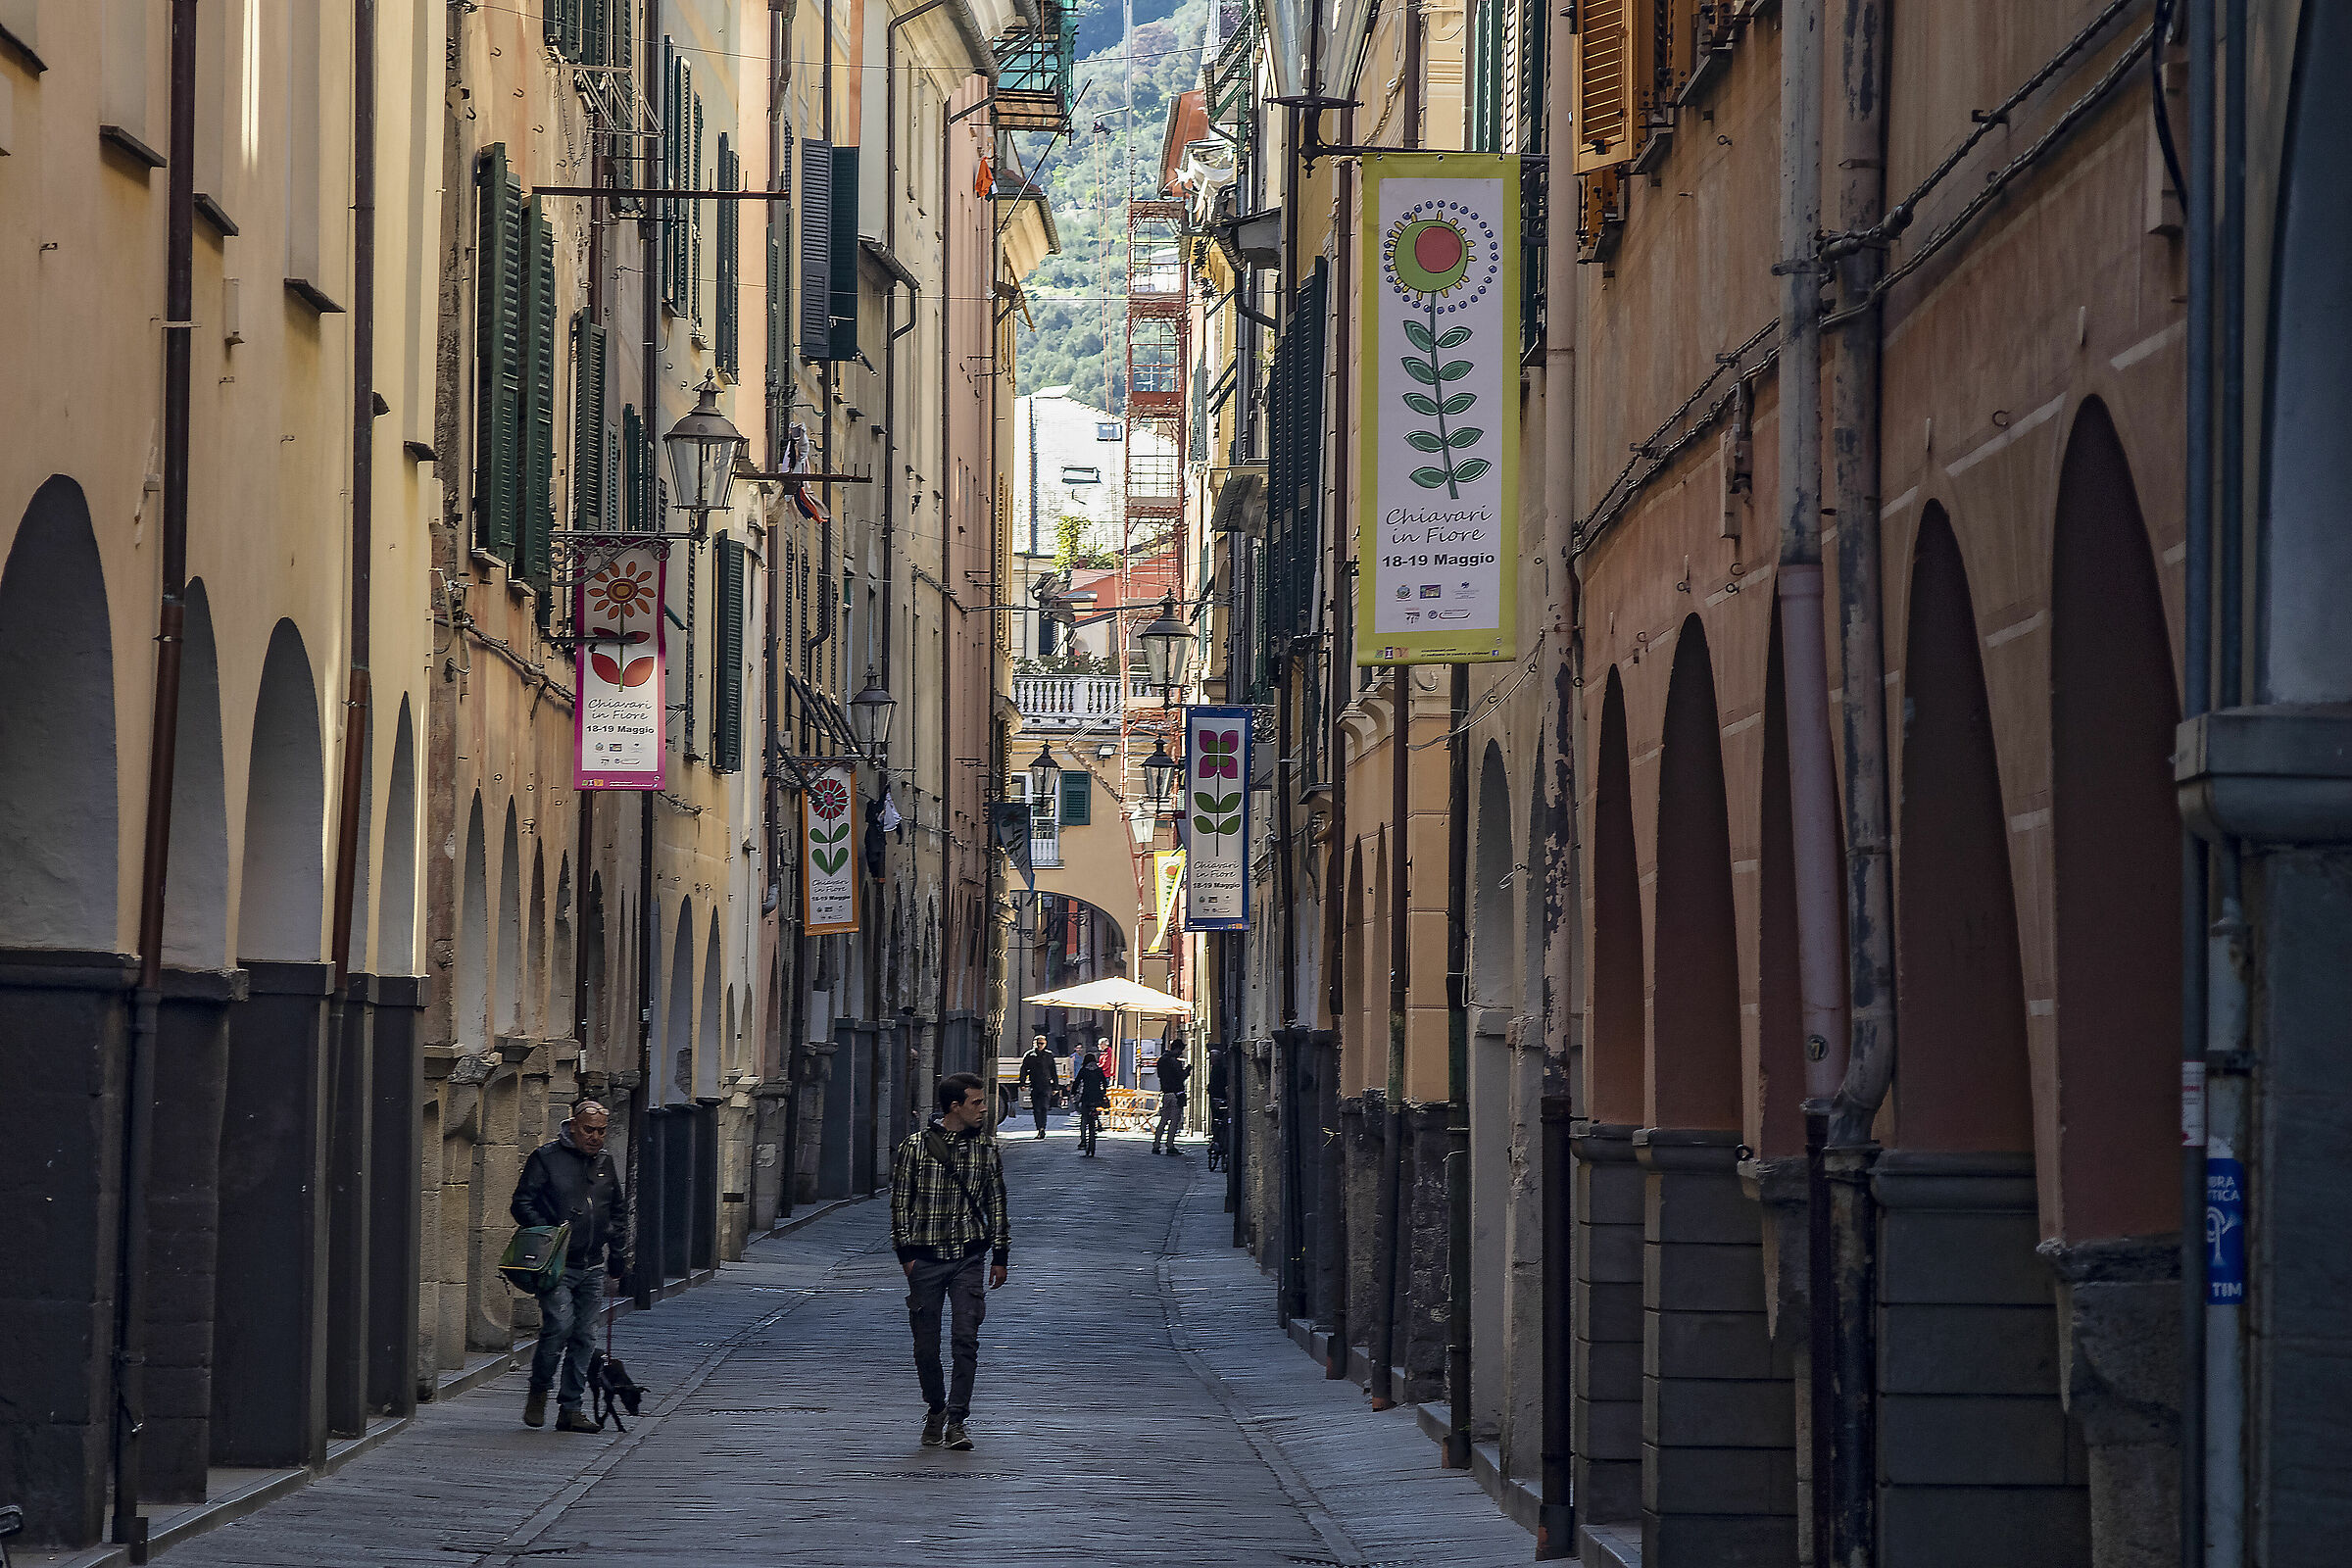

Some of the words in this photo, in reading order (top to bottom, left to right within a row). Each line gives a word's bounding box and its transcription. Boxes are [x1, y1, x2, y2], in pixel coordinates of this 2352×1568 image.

[1386, 505, 1493, 525] Chiavari
[1392, 527, 1420, 544] in
[1426, 525, 1487, 543] Fiore
[1382, 555, 1428, 567] 18-19
[1434, 553, 1495, 567] Maggio
[588, 698, 652, 710] Chiavari
[592, 710, 610, 719] in
[612, 710, 649, 719] Fiore
[617, 725, 655, 735] Maggio
[1194, 860, 1239, 870] Chiavari
[1210, 869, 1237, 878] Fiore
[2212, 1282, 2242, 1297] TIM
